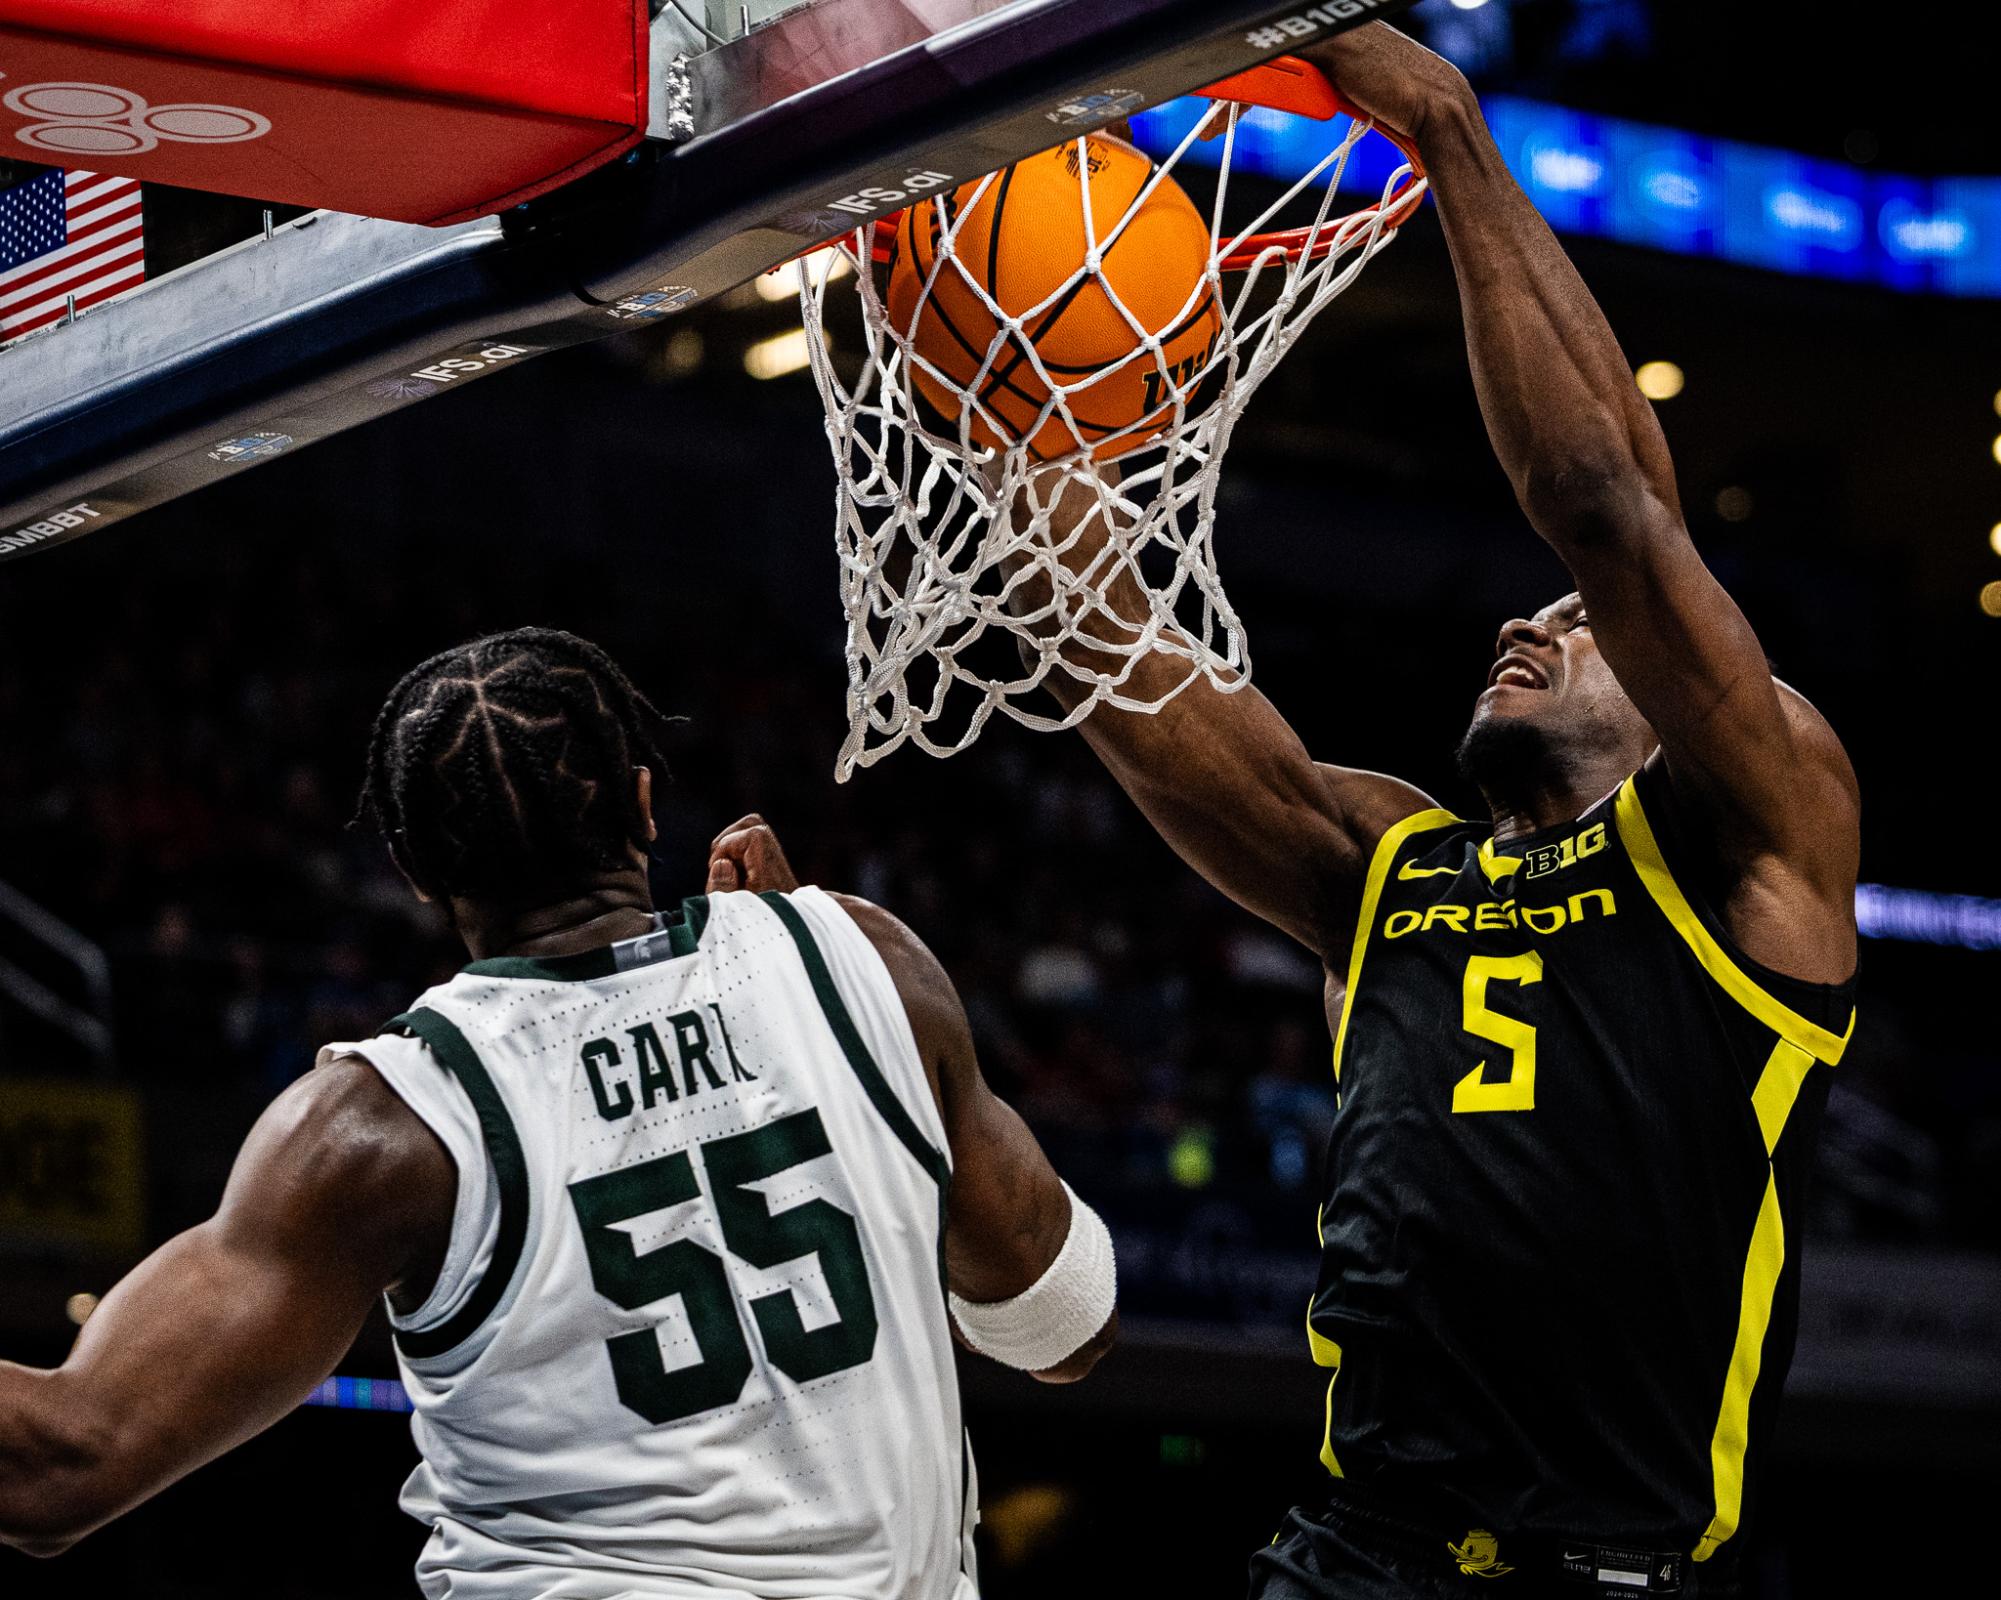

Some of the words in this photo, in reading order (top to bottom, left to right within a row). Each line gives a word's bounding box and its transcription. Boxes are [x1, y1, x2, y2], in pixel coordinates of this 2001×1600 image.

[826, 170, 954, 215] IFS.ai
[410, 344, 528, 383] IFS.ai
[1526, 822, 1606, 880] B1G
[1452, 949, 1544, 1113] 5
[566, 1105, 879, 1426] 55
